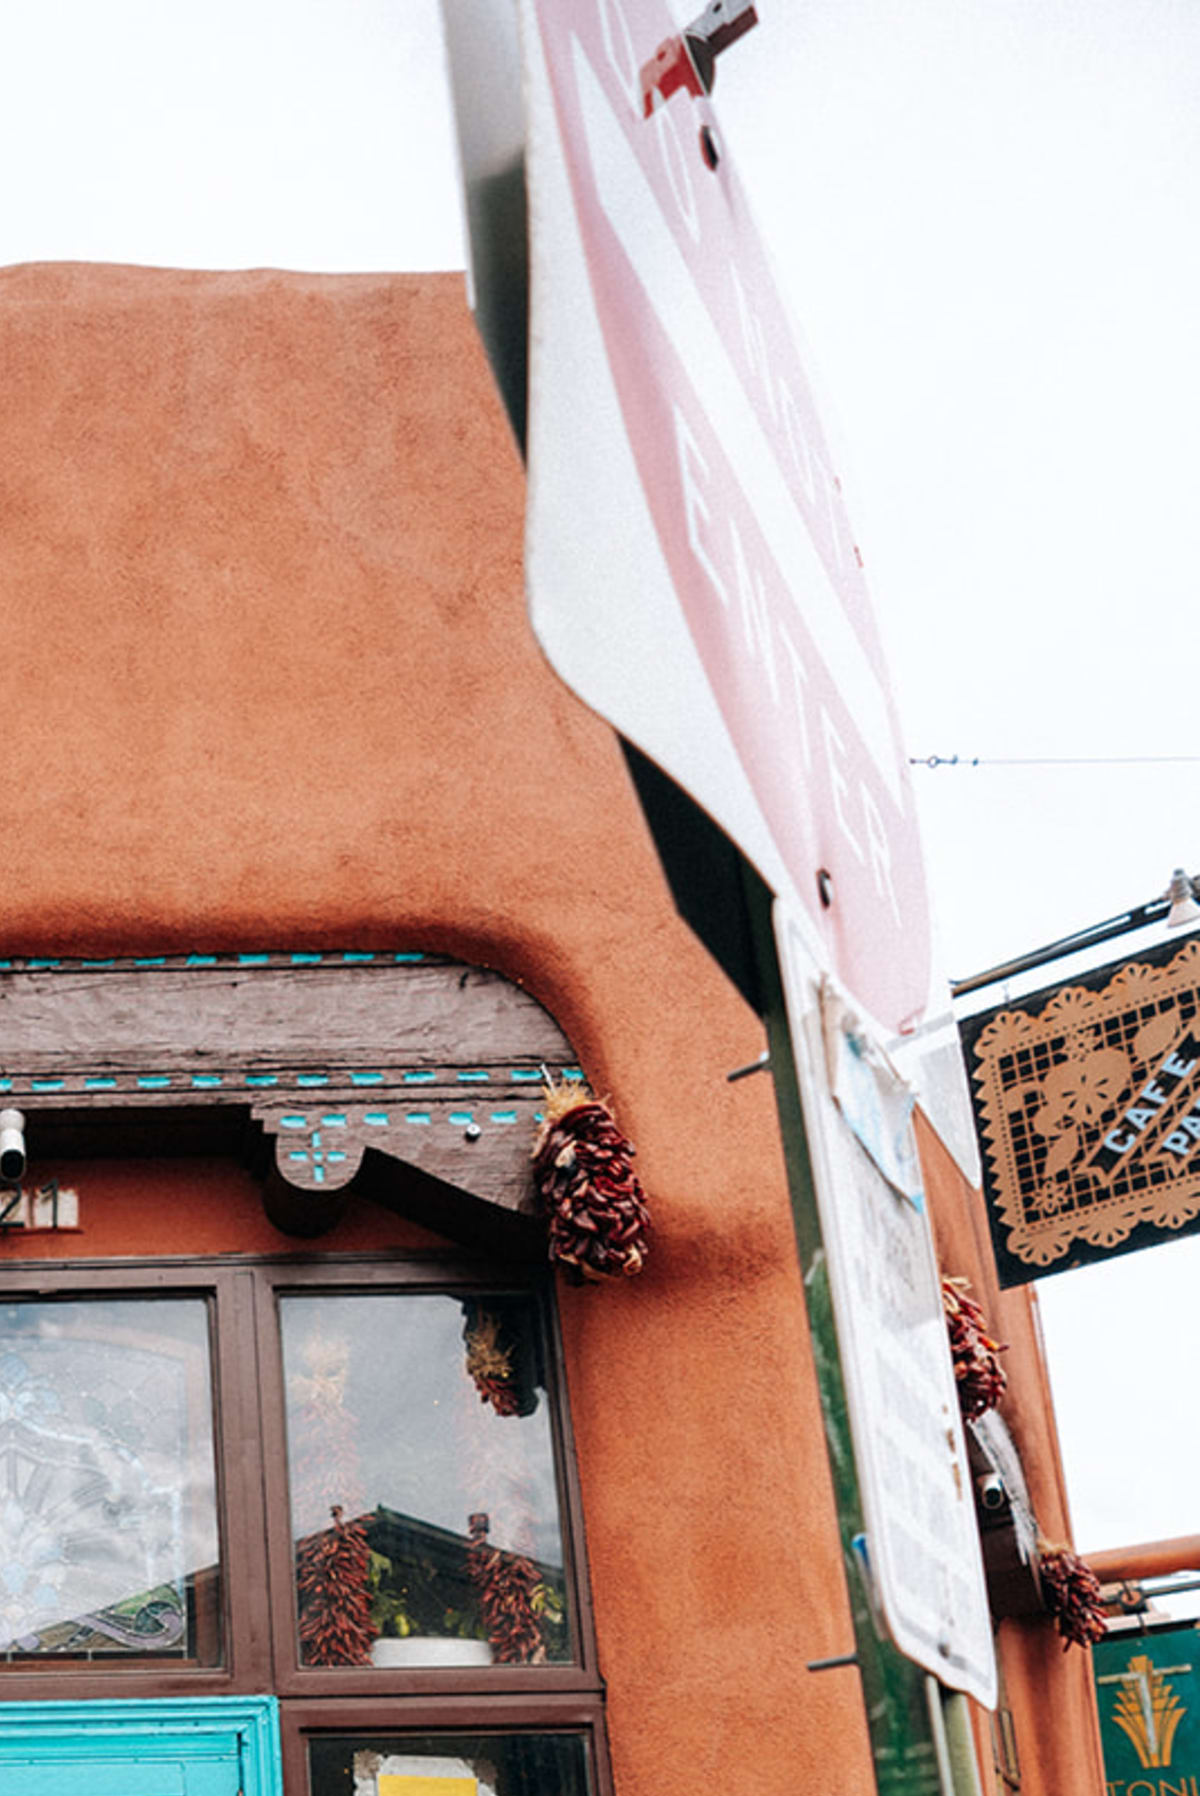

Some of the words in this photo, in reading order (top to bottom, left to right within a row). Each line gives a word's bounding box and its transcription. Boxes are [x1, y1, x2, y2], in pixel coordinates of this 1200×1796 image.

[672, 403, 902, 928] ENTER
[1103, 1051, 1198, 1153] CAFE
[1161, 1098, 1200, 1156] PA
